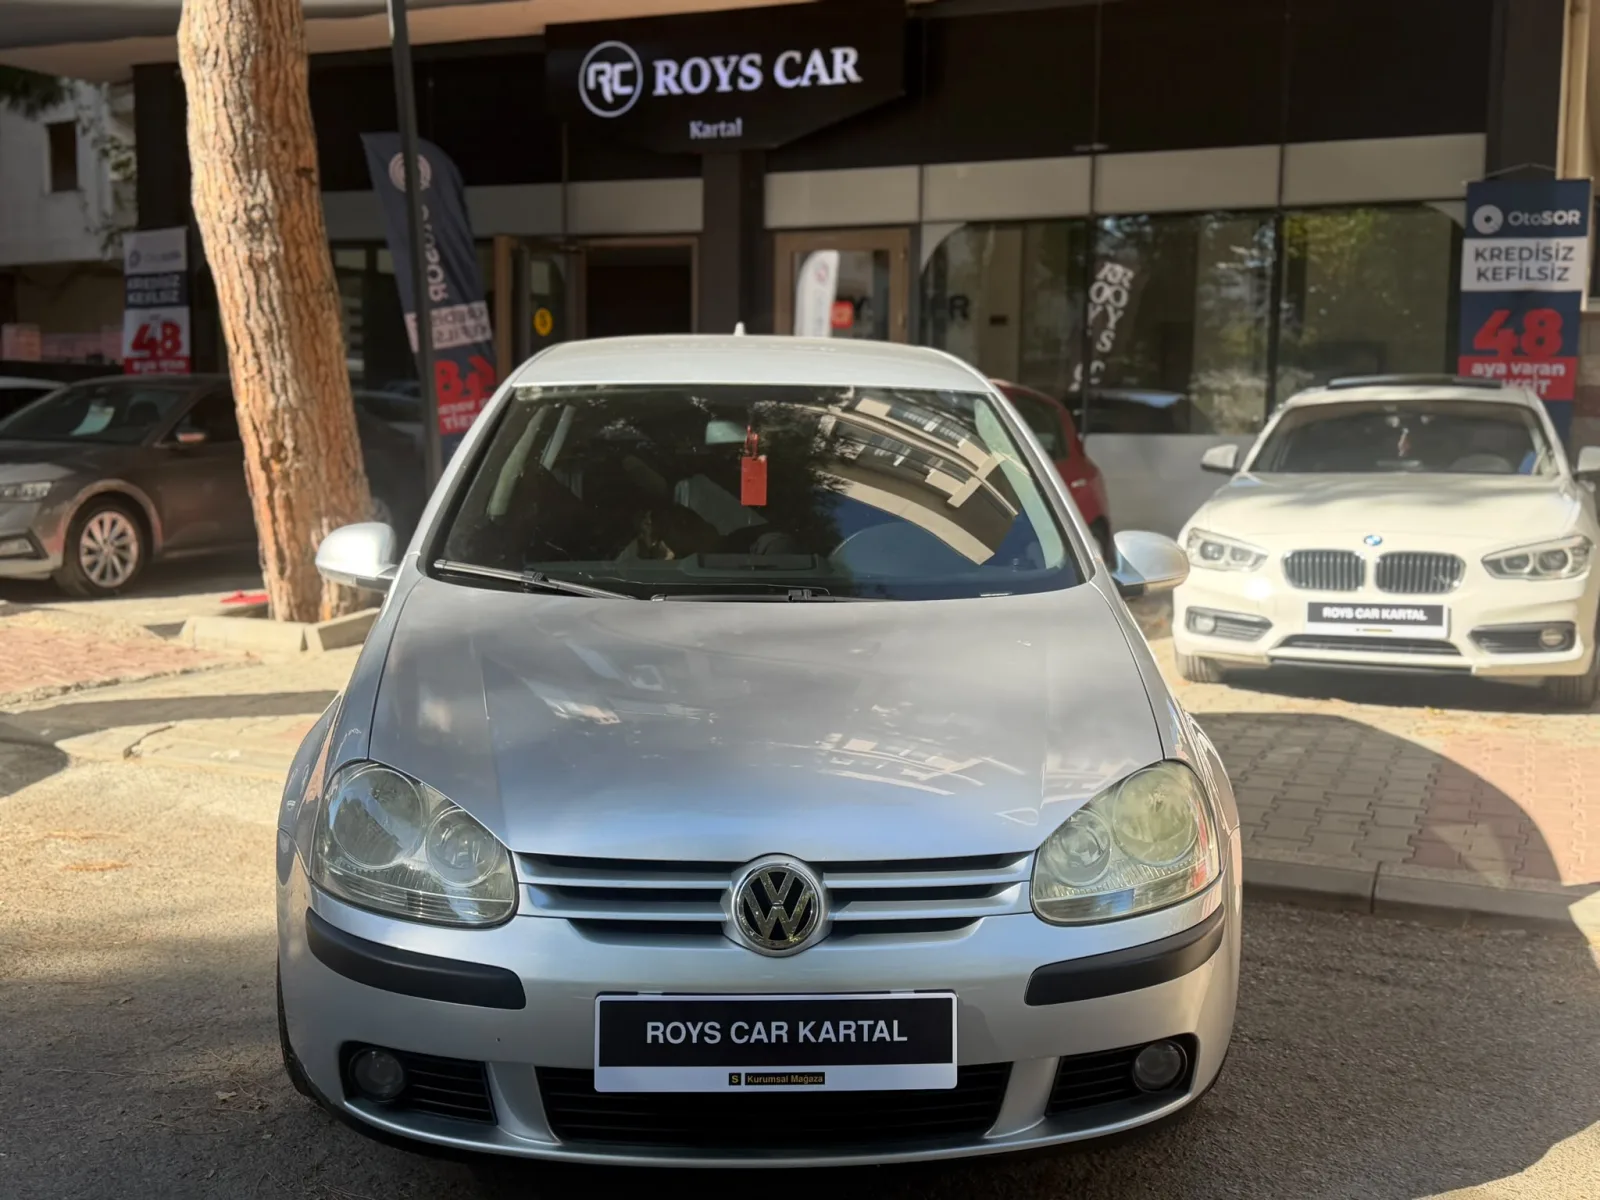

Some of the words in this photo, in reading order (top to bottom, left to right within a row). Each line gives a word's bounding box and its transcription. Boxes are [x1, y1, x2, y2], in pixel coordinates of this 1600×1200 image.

[652, 53, 763, 96] ROYS
[773, 46, 863, 89] CAR
[689, 118, 743, 139] Kartal
[1508, 209, 1581, 226] OtoSOR
[1474, 242, 1575, 262] KREDİSİZ
[1476, 263, 1571, 282] KEFİLSİZ
[131, 320, 182, 357] 48
[1473, 308, 1563, 358] 48
[1471, 361, 1507, 377] aya
[1511, 361, 1566, 377] varan
[1322, 606, 1354, 619] ROYS
[1355, 607, 1380, 619] CAR
[1381, 608, 1428, 621] KARTAL
[646, 1021, 721, 1045] ROYS
[730, 1020, 788, 1044] CAR
[798, 1020, 908, 1043] KARTAL
[747, 1075, 788, 1083] Kurumsal
[791, 1074, 823, 1085] Mağaza
